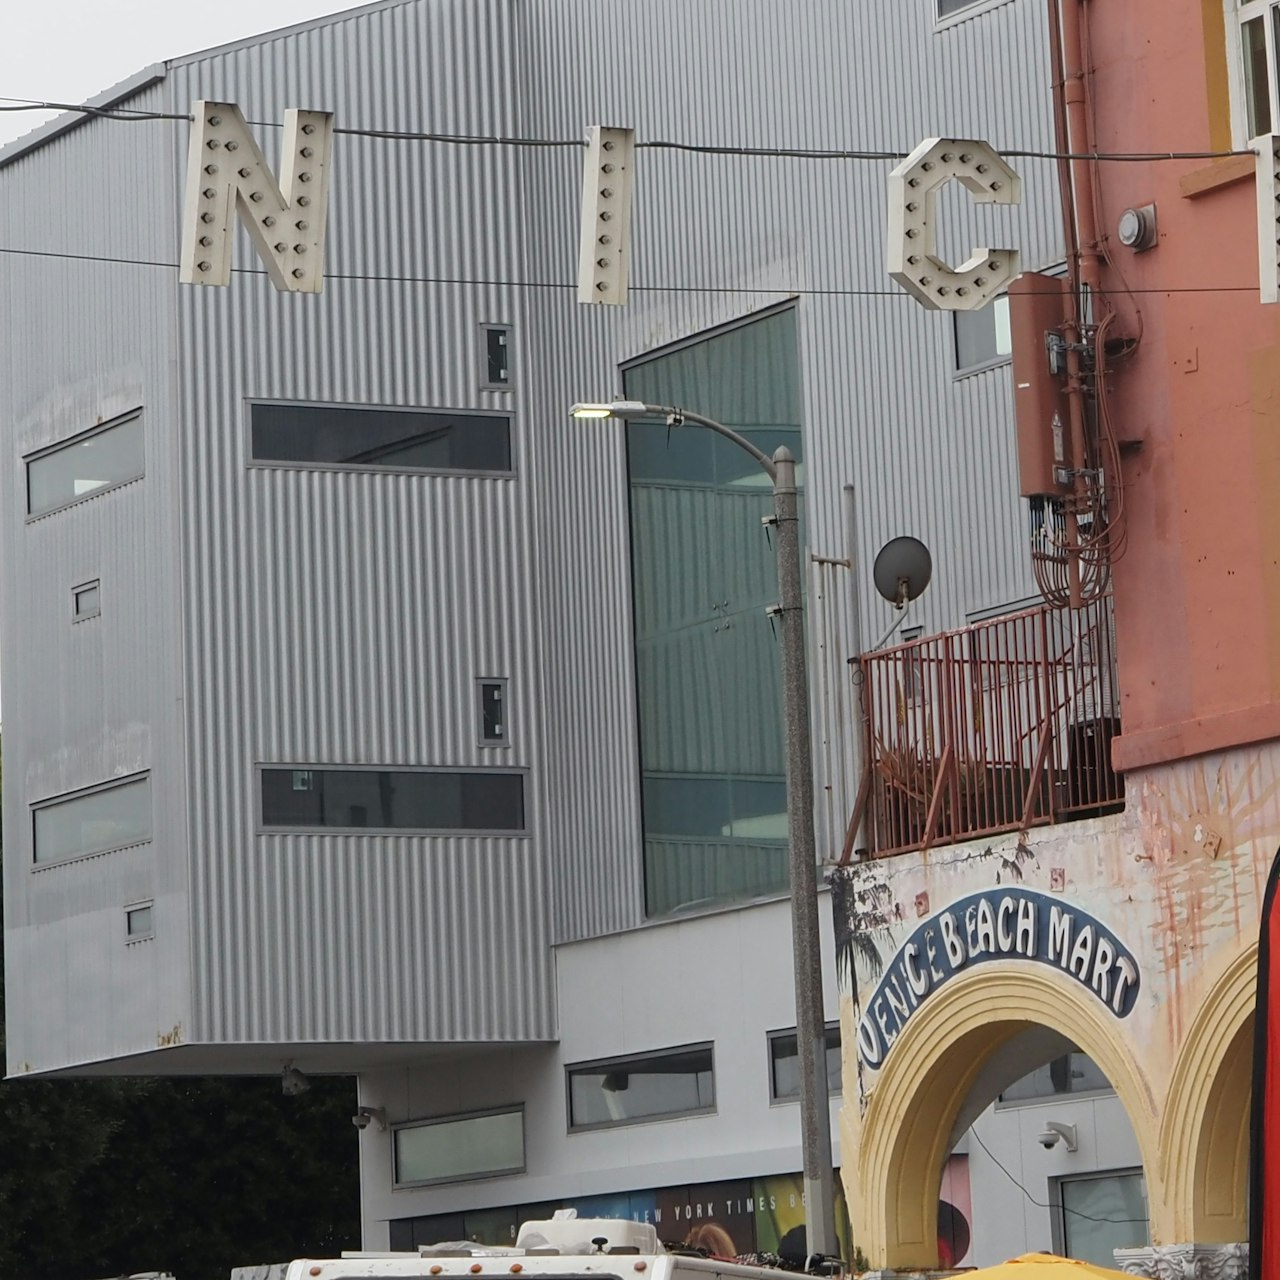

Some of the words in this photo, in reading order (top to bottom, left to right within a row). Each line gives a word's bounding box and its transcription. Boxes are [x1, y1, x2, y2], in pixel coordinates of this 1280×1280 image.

[939, 896, 1038, 969] BEACH
[1048, 905, 1137, 1014] MART
[674, 1202, 715, 1221] YORK
[726, 1197, 776, 1216] TIMES
